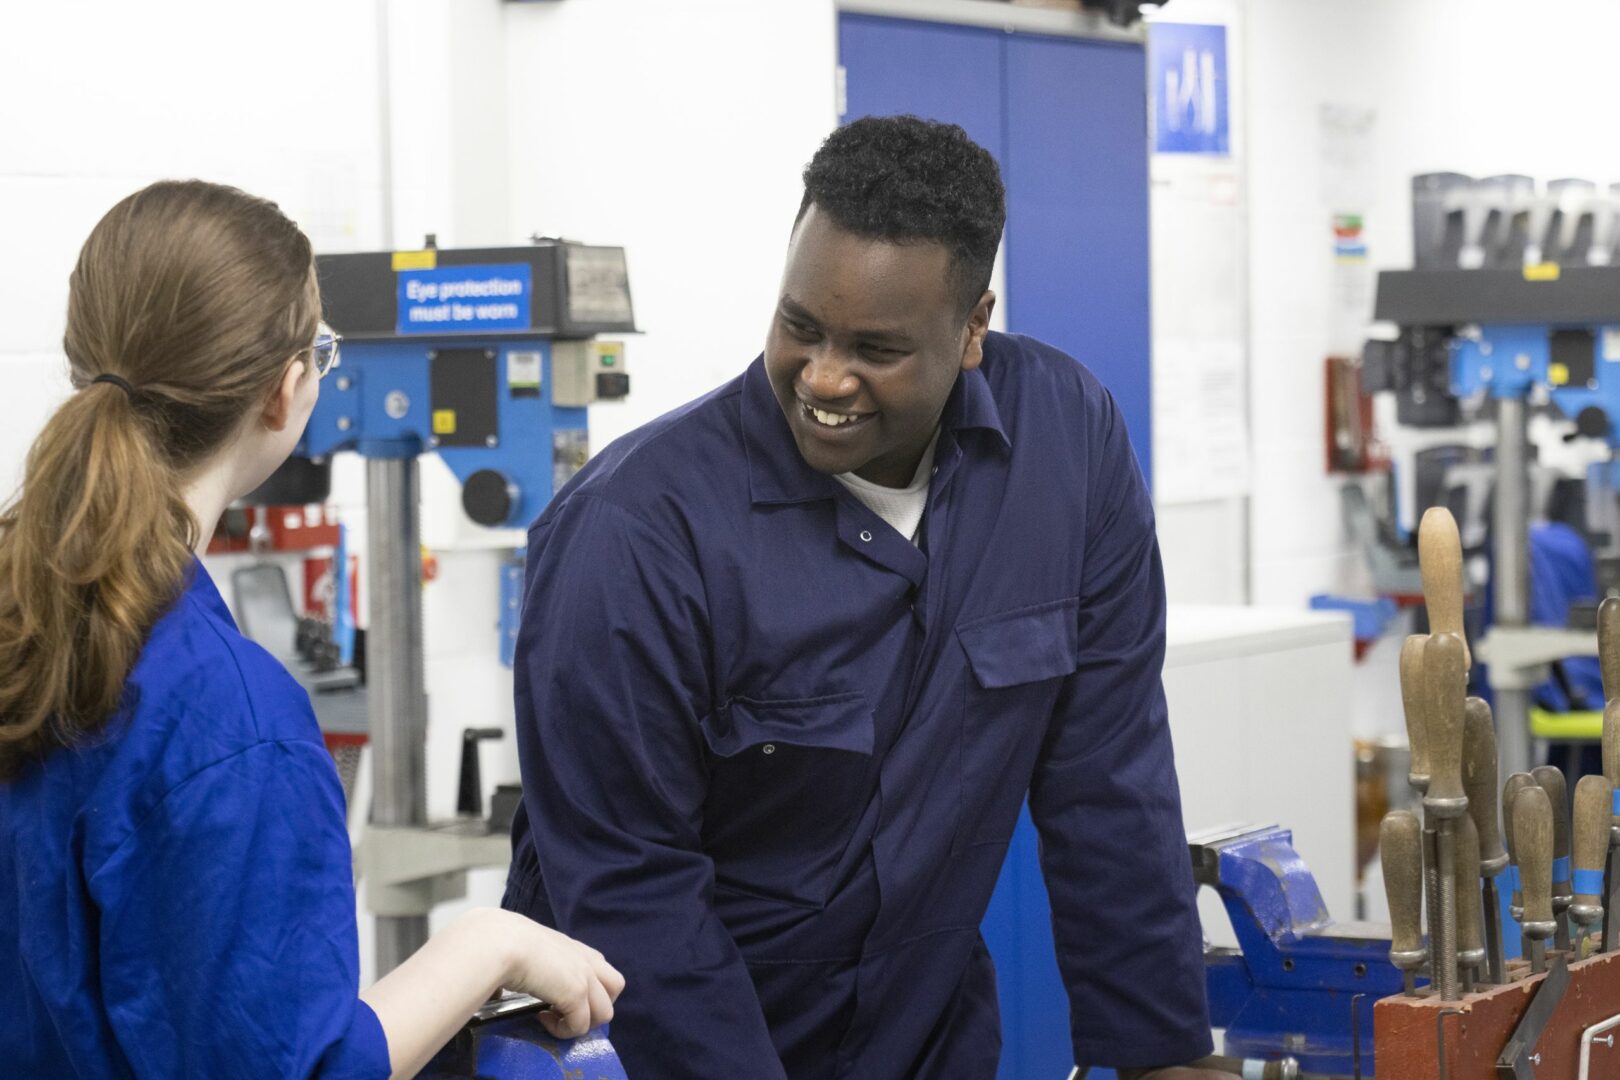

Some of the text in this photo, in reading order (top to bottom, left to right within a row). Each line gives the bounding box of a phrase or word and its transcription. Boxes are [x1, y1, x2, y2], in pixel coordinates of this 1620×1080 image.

[407, 278, 522, 302] Eye protection
[410, 303, 518, 322] must be worn
